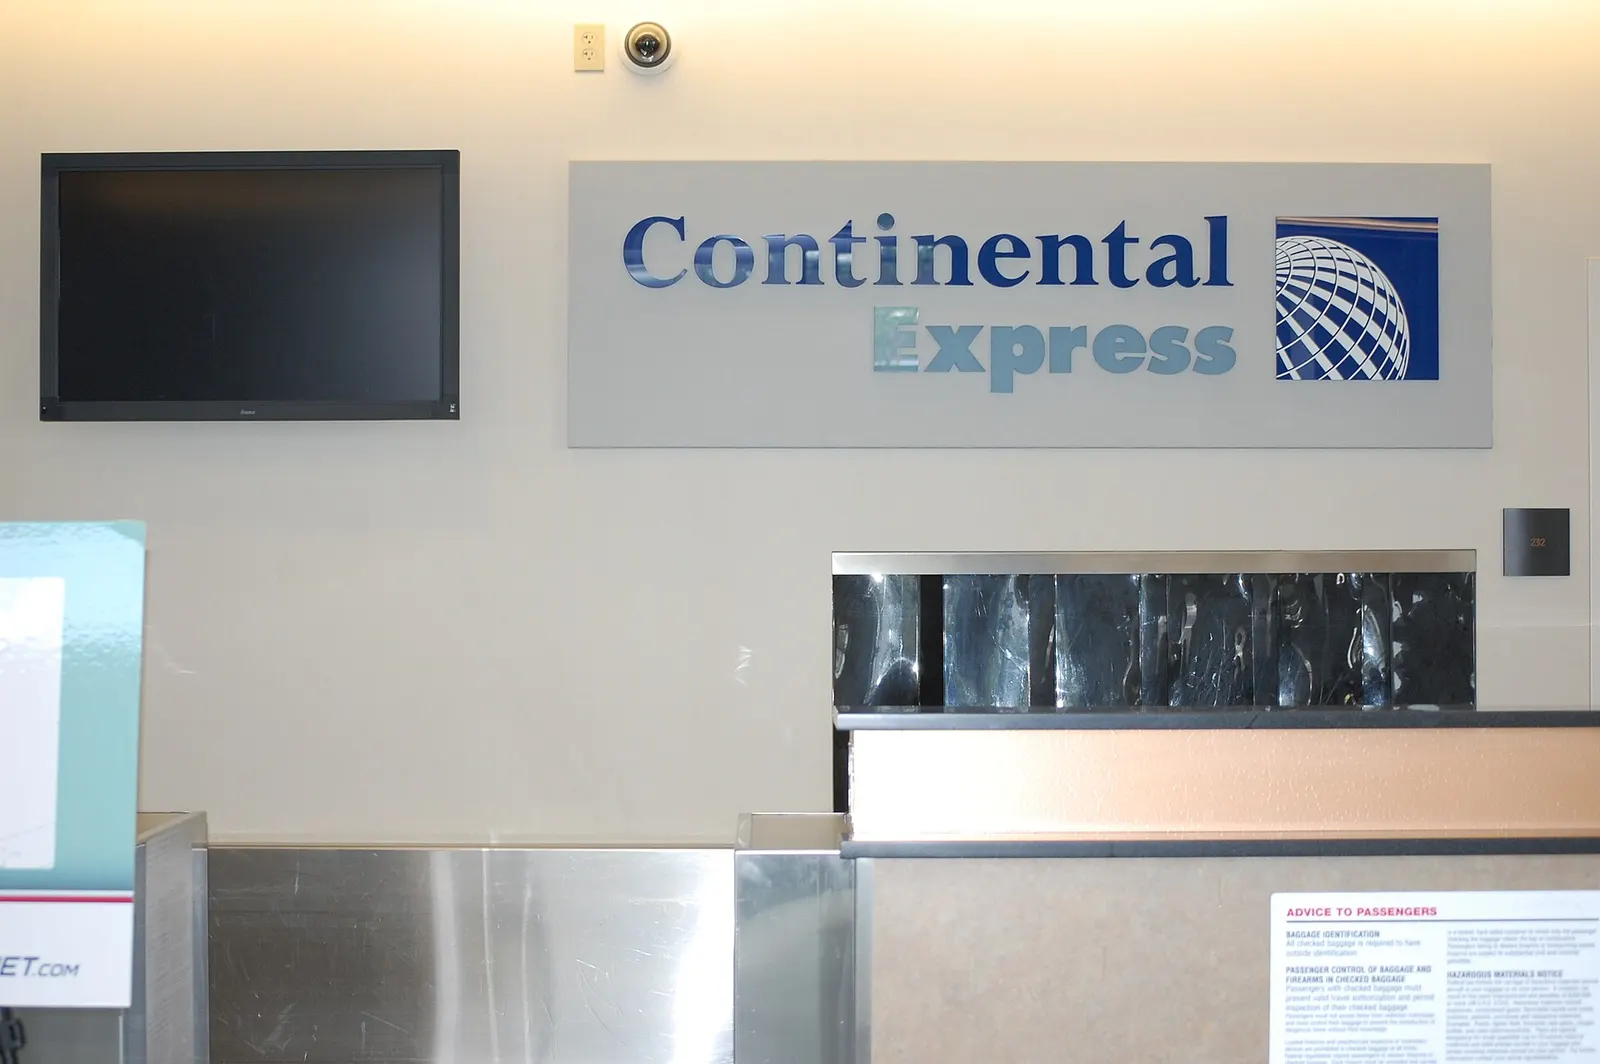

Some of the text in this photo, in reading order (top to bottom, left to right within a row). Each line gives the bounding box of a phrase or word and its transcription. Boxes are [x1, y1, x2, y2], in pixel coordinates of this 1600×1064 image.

[622, 212, 1235, 289] Continental
[873, 305, 1237, 393] Express
[1286, 906, 1438, 917] ADVICE TO PASSENGERS
[1285, 930, 1380, 938] BAGGAGE IDENTIFICATION
[1297, 939, 1325, 947] checked
[1327, 939, 1356, 948] baggage
[1365, 939, 1394, 948] required
[1285, 949, 1311, 957] outside
[0, 956, 80, 977] ET.COM
[1285, 966, 1329, 974] PASSENGER
[1331, 966, 1365, 974] CONTROL
[1380, 965, 1414, 973] BAGGAGE
[1416, 965, 1432, 973] AND
[1371, 975, 1406, 983] BAGGAGE
[1446, 970, 1563, 979] HAZARDOUS MATERIALS NOTICE
[1285, 985, 1325, 993] Passengers
[1343, 984, 1371, 992] checked
[1373, 984, 1402, 993] baggage
